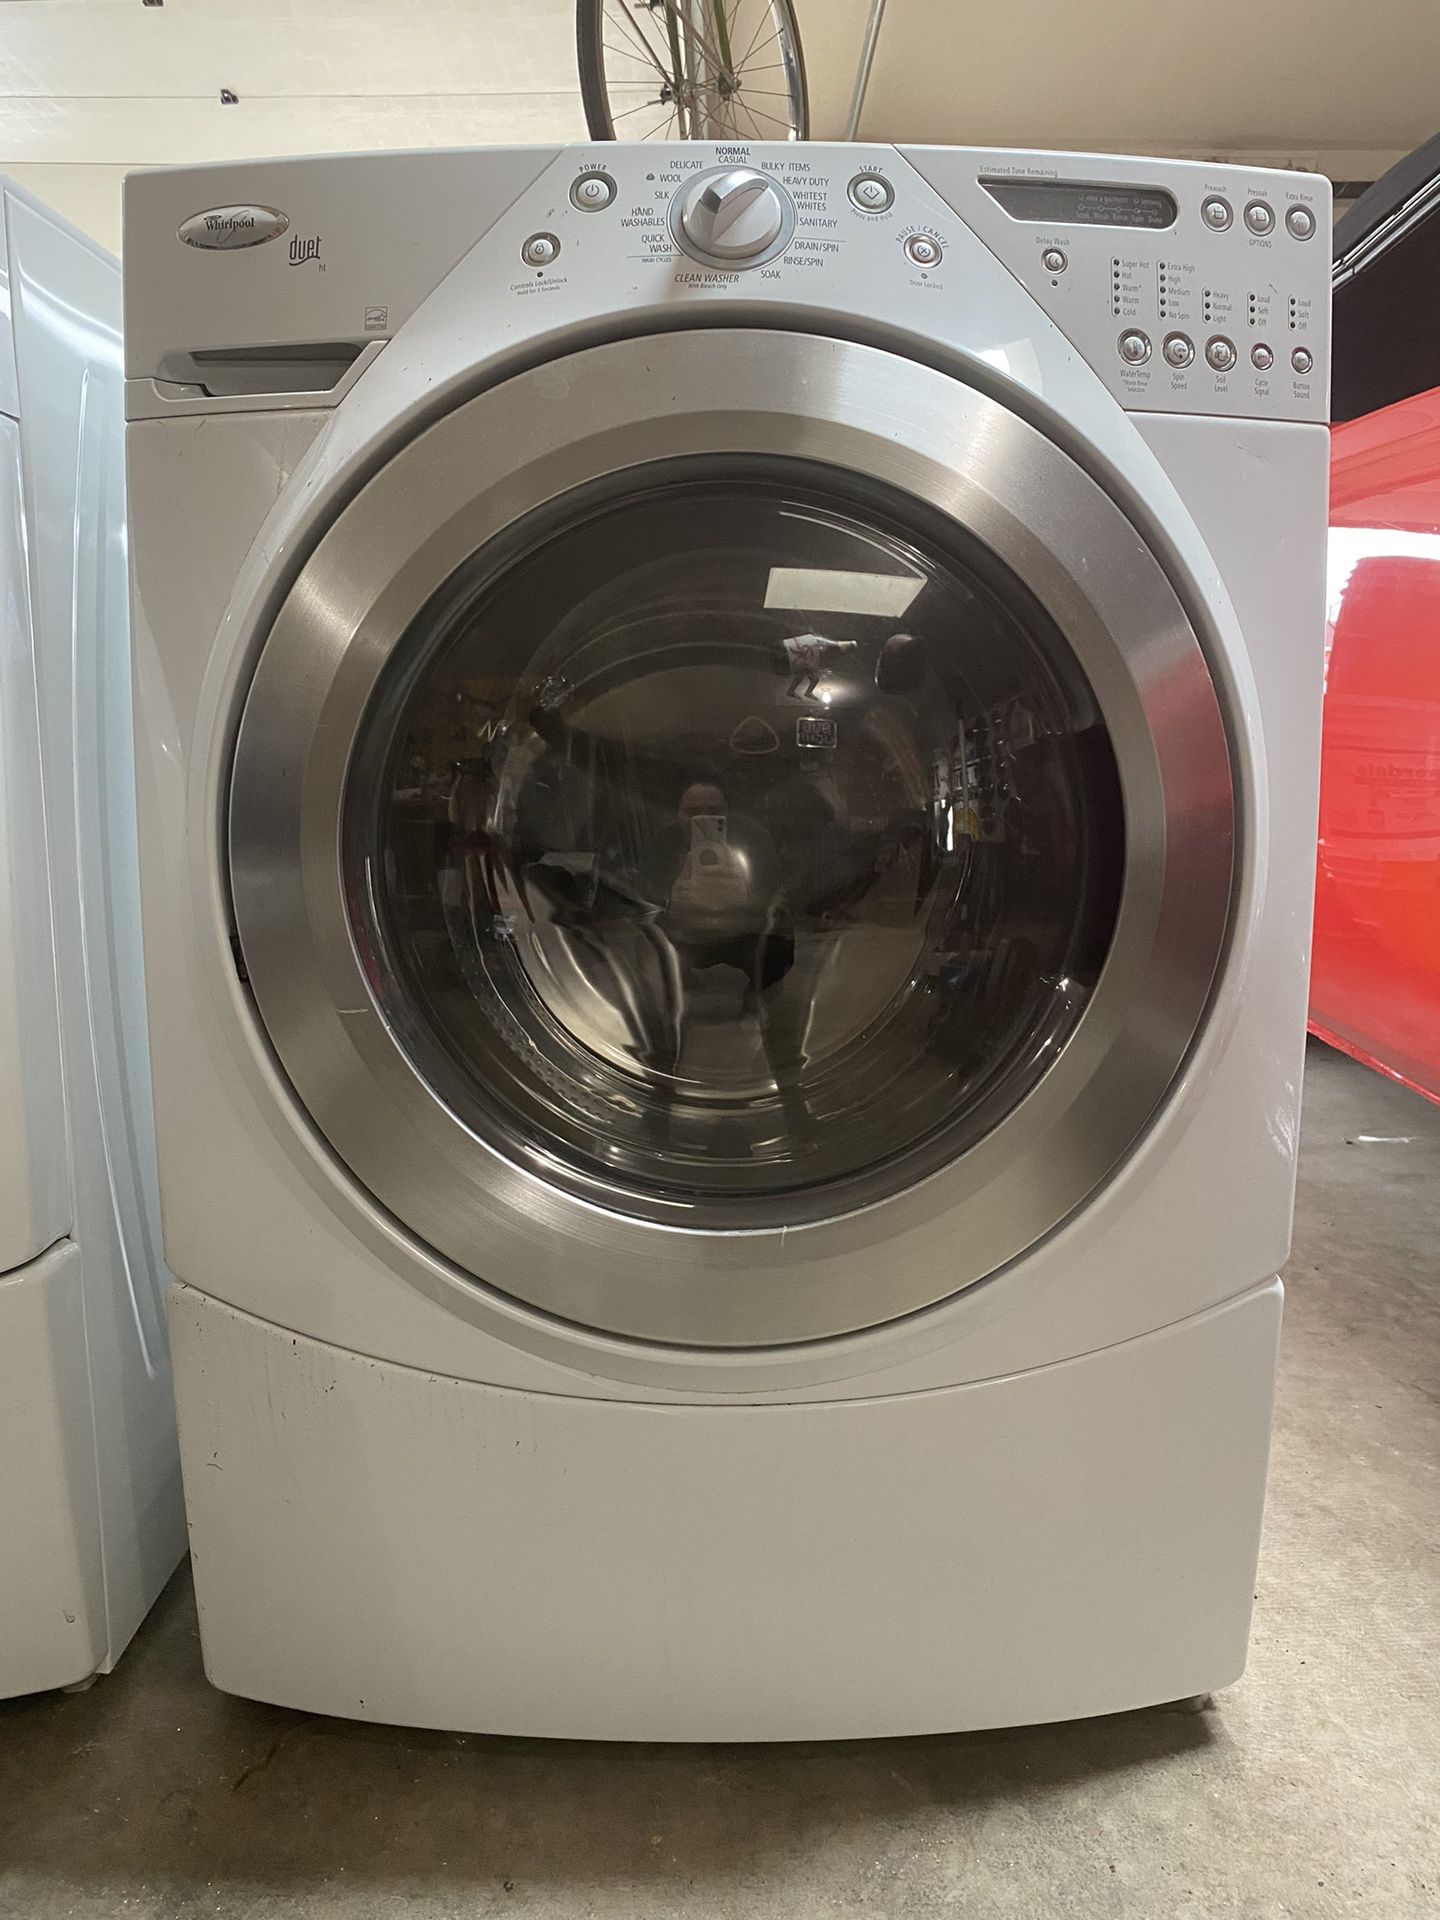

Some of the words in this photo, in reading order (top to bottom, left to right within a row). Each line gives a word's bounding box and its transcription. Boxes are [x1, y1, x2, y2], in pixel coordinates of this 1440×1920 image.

[716, 147, 750, 155] NORMAL
[718, 156, 747, 164] CASUAL
[578, 164, 607, 173] POWER
[670, 161, 703, 169] DELICATE
[762, 162, 785, 171] BULKY
[789, 163, 810, 172] ITEMS
[860, 165, 883, 174] START
[980, 165, 1011, 174] Estimated
[1012, 167, 1026, 175] Time
[1027, 168, 1058, 179] Remaining
[660, 174, 682, 182] WOOL
[783, 177, 807, 185] HEAVY
[809, 178, 829, 186] DUTY
[792, 192, 827, 200] WHITEST
[796, 202, 826, 211] WHITES
[632, 208, 654, 216] HAND
[206, 217, 254, 231] Whirlpool
[621, 218, 665, 227] WASHABLES
[800, 218, 838, 228] SANITARY
[642, 234, 665, 244] QUICK
[896, 225, 916, 243] PAUSE
[922, 226, 950, 249] CANCEL
[1036, 236, 1052, 246] Delay
[1054, 237, 1070, 246] Wash
[1248, 239, 1272, 248] OPTIONS
[290, 234, 322, 266] duet
[784, 256, 824, 267] RINSE/SPIN
[1122, 260, 1138, 269] Super
[1168, 263, 1181, 271] Extra
[1183, 264, 1195, 273] High
[674, 274, 702, 283] CLEAN
[704, 274, 740, 283] WASHER
[761, 270, 781, 278] SOAK
[1168, 275, 1181, 284] High
[510, 280, 534, 291] Controls
[535, 278, 568, 288] Lock/Unlock
[1168, 288, 1190, 296] Medium
[1122, 296, 1139, 304] Warm
[1213, 303, 1232, 311] Normal
[1122, 308, 1136, 316] Cold
[1173, 372, 1185, 381] Spin
[1216, 376, 1226, 384] Soil
[1170, 382, 1188, 391] Speed
[1255, 379, 1269, 388] Cycle
[1293, 382, 1310, 390] Button
[1214, 385, 1228, 393] Level
[1254, 388, 1270, 397] Signal
[1294, 391, 1310, 399] Sound
